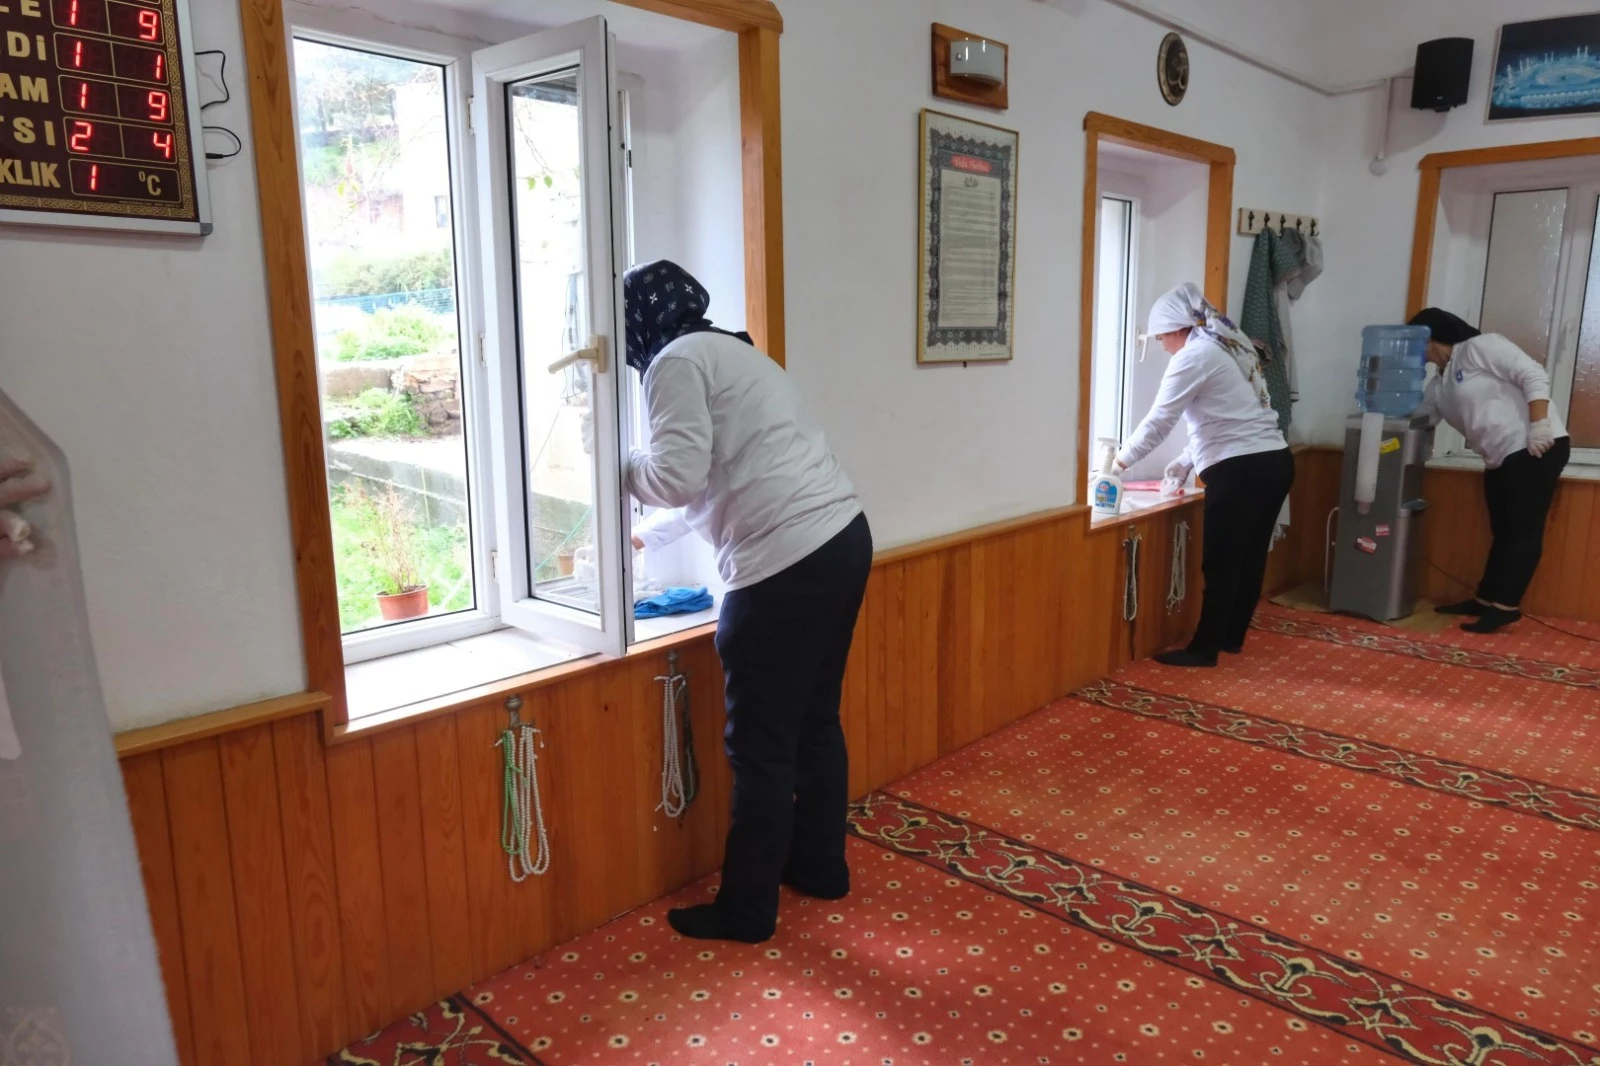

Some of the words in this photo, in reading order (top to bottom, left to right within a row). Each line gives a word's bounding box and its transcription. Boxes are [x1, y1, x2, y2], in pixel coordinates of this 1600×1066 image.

[71, 0, 78, 26] 1
[139, 10, 158, 40] 9
[75, 41, 82, 67] 1
[156, 54, 163, 80] 1
[81, 82, 88, 109] 1
[148, 91, 167, 120] 9
[0, 115, 56, 146] SI
[71, 121, 93, 151] 2
[153, 132, 172, 159] 4
[91, 164, 98, 191] 1
